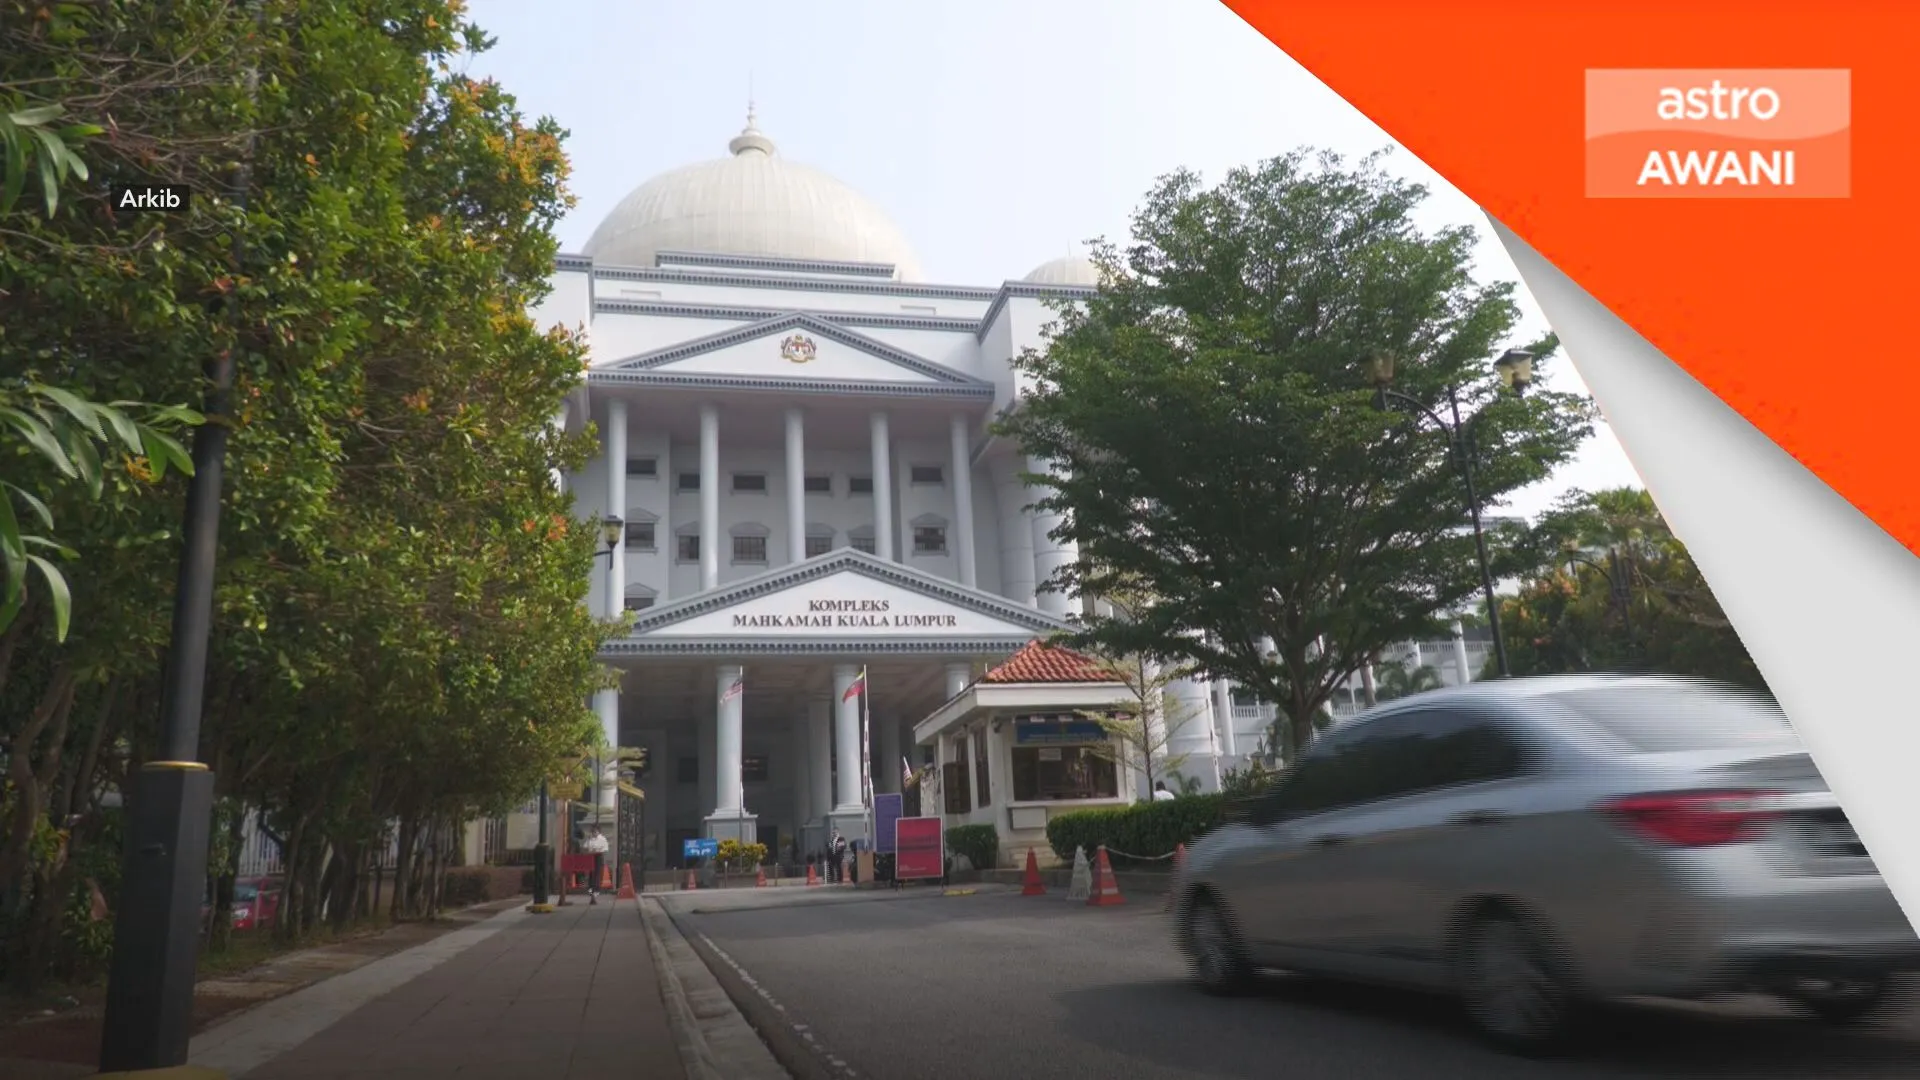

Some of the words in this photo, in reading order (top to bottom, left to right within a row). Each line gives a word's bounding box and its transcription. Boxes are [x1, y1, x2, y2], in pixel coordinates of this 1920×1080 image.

[809, 600, 890, 612] KOMPLEKS
[733, 614, 832, 627] MAHKAMAH
[837, 614, 889, 627] KUALA
[895, 614, 957, 627] LUMPUR
